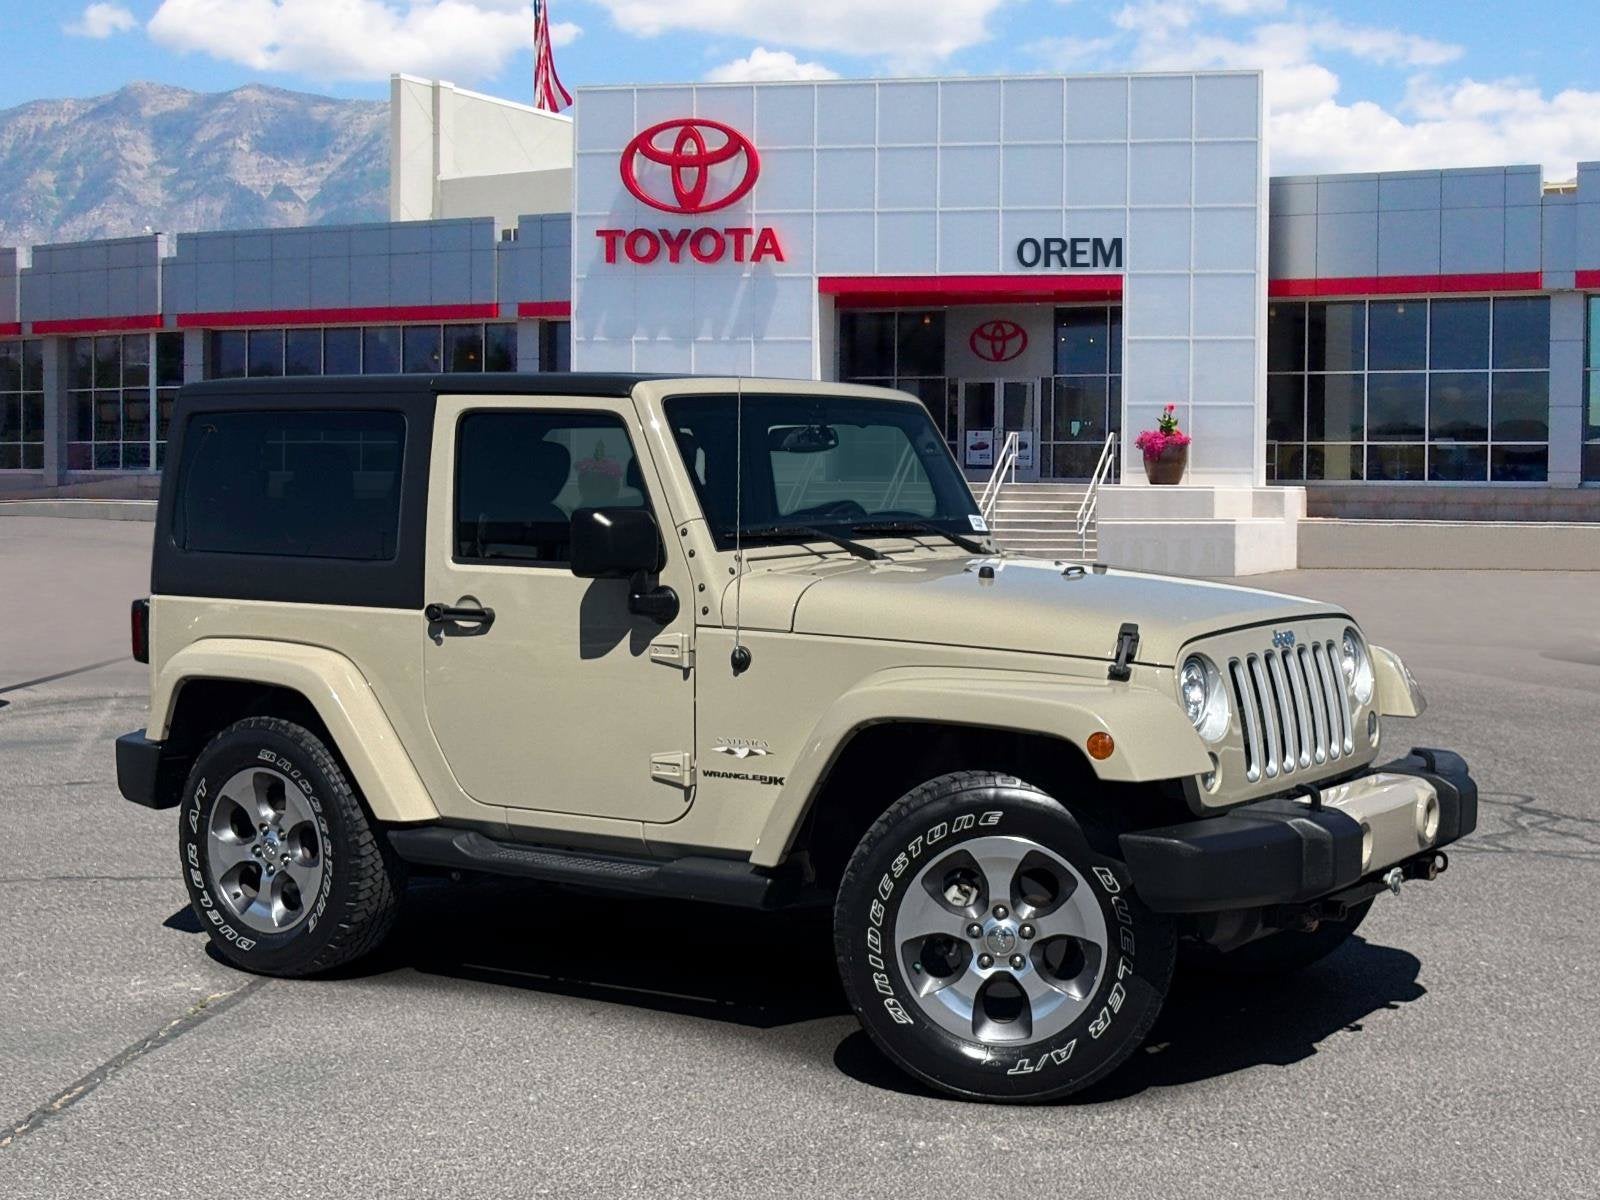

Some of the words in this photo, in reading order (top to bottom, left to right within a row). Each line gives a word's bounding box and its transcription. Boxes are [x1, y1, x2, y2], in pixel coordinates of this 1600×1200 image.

[596, 228, 784, 264] TOYOTA
[1017, 237, 1122, 267] OREM
[188, 776, 208, 834] A/T
[257, 749, 333, 933] BRIDGESTONE
[187, 842, 257, 951] DUELER
[867, 811, 1003, 1025] BRIDGESTONE
[1088, 866, 1136, 1040] DUELER
[1007, 1038, 1078, 1075] A/T
